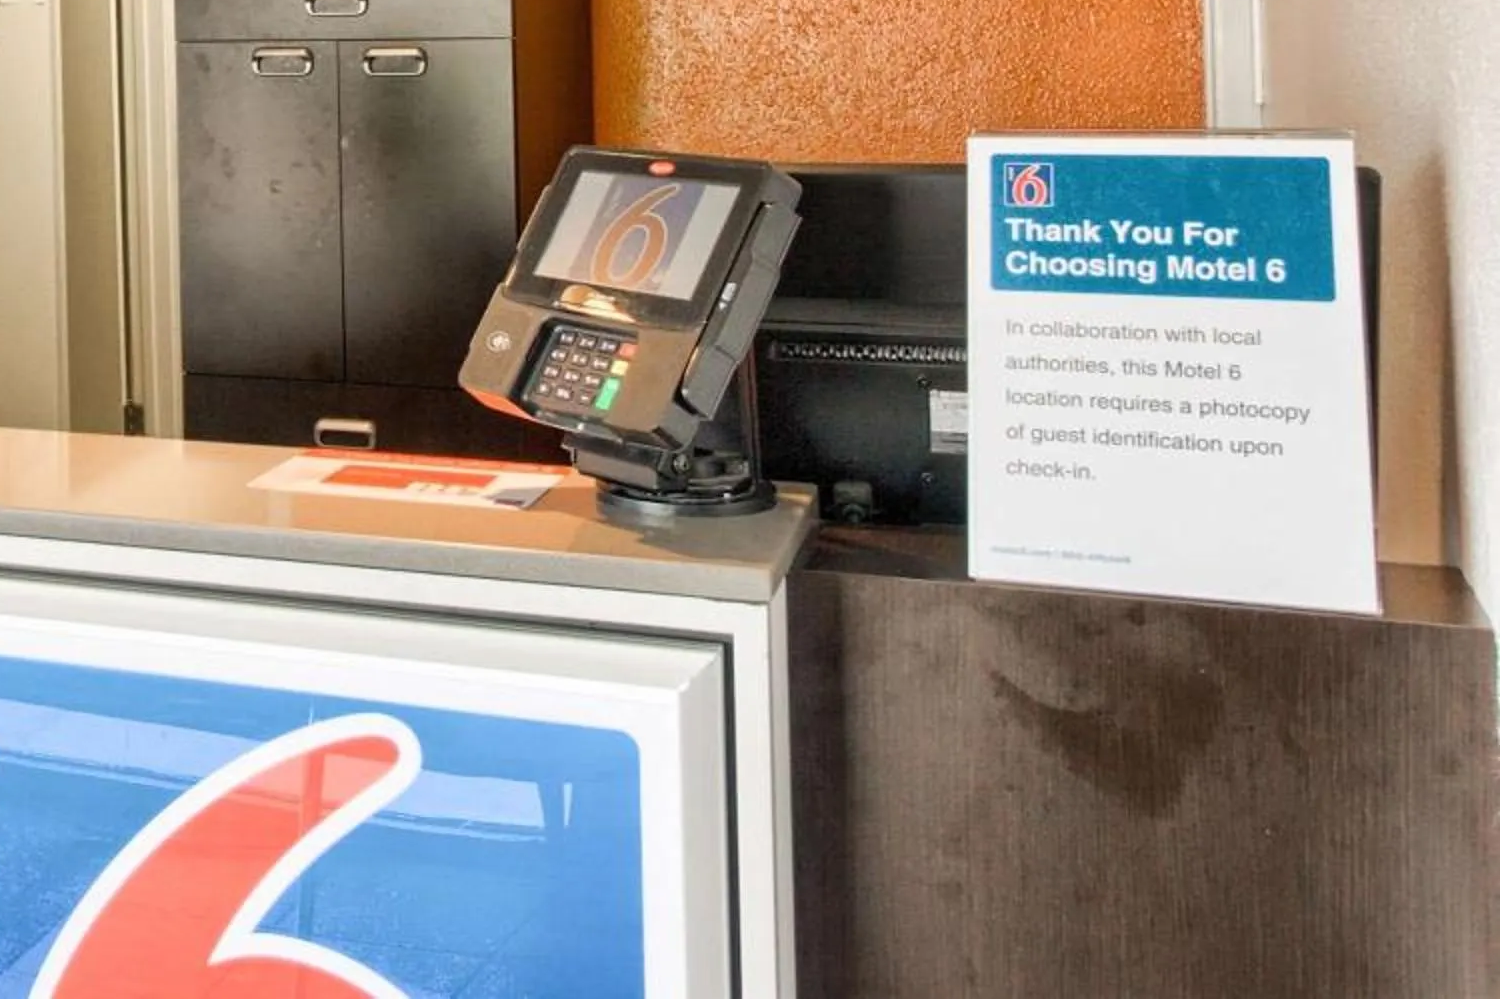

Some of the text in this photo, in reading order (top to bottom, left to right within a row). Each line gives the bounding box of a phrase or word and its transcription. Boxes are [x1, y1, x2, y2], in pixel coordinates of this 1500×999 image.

[1011, 163, 1049, 207] 6
[591, 183, 681, 288] 6
[1004, 217, 1239, 247] Thank You For
[1005, 250, 1287, 284] Choosing Motel 6
[1006, 319, 1262, 346] In collaboration with local
[1004, 354, 1242, 381] authorities, this Motel 6
[1006, 388, 1311, 426] location requires a photocopy
[1006, 423, 1284, 458] of guest identification upon
[1006, 458, 1097, 480] check-in.
